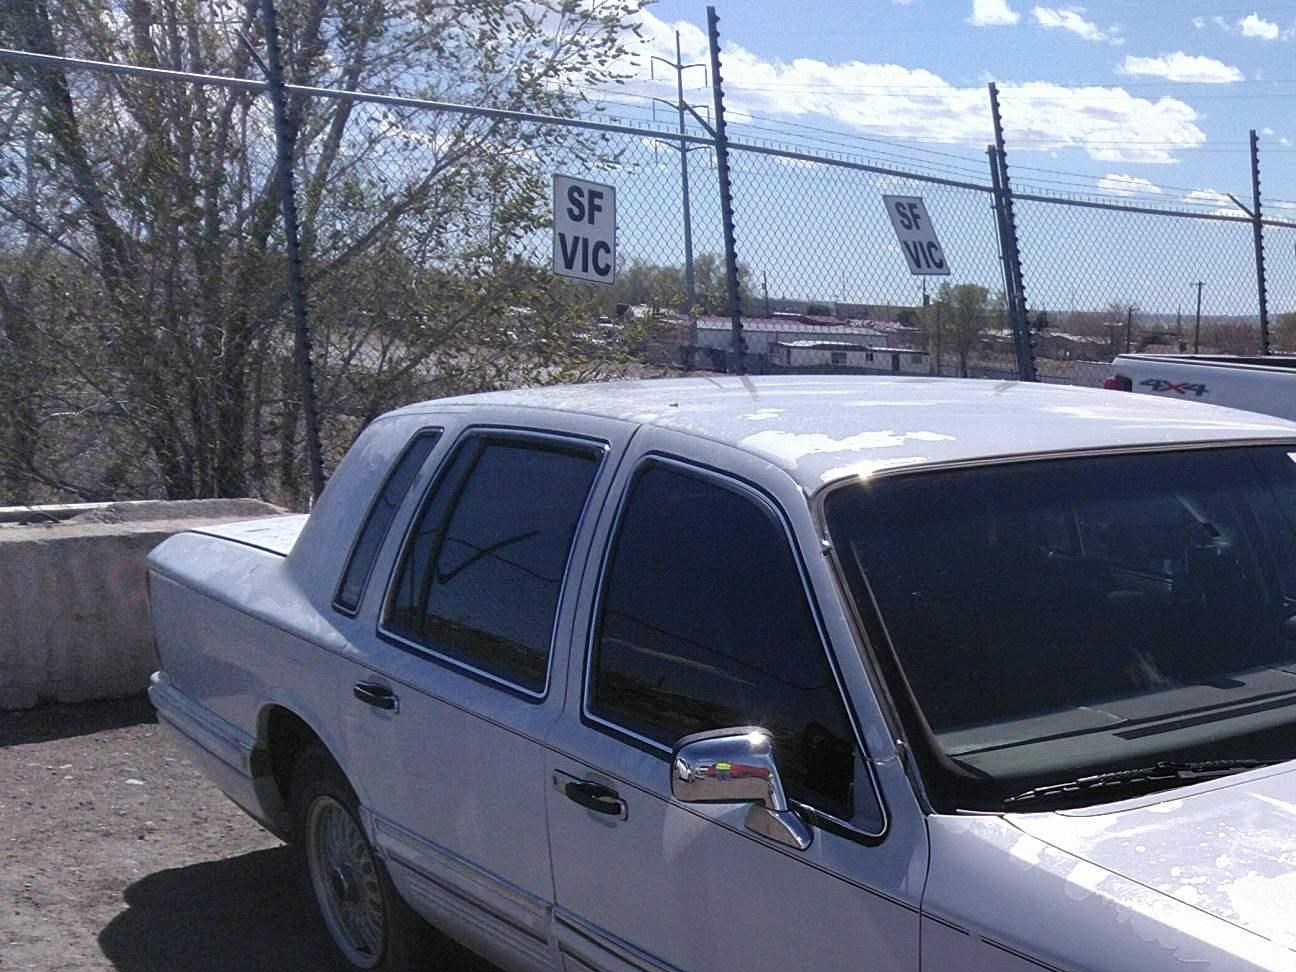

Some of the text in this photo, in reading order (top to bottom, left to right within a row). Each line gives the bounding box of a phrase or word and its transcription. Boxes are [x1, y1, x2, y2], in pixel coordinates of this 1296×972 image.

[566, 184, 604, 225] SF
[894, 200, 923, 232] SF
[558, 235, 613, 279] VIC
[902, 239, 945, 271] VIC
